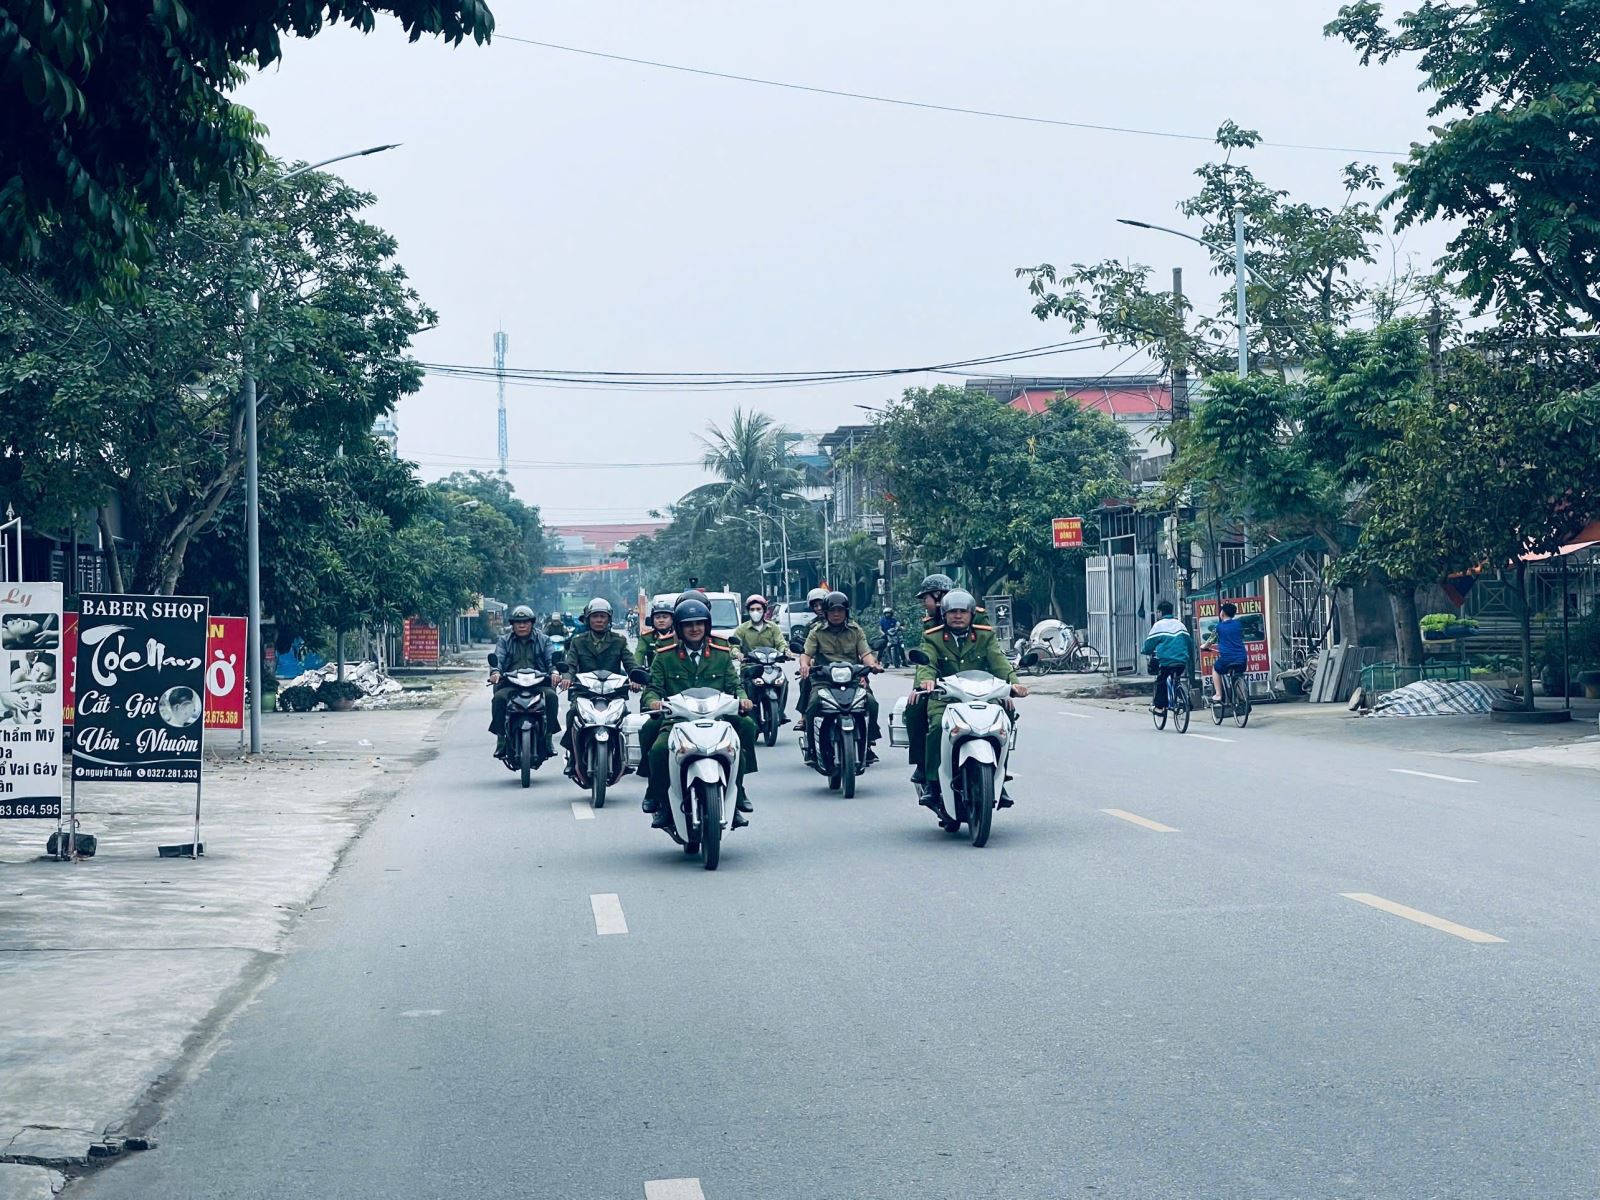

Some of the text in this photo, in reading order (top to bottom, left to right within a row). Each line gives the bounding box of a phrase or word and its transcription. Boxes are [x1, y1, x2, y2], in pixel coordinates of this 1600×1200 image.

[1, 588, 32, 607] Ly
[82, 600, 205, 622] BABER SHOP
[1200, 604, 1216, 617] XAY
[81, 624, 148, 687] Tóc
[146, 638, 201, 674] Nam
[1250, 644, 1264, 652] GẠO
[78, 690, 111, 716] Cắt
[125, 693, 159, 718] Gội
[35, 728, 55, 743] Mỹ
[76, 727, 120, 753] Uốn
[136, 728, 199, 755] Nhuộm
[10, 762, 29, 776] Vai
[33, 762, 58, 777] Gáy
[114, 767, 132, 777] Tuấn
[146, 768, 198, 779] 0327.281.333
